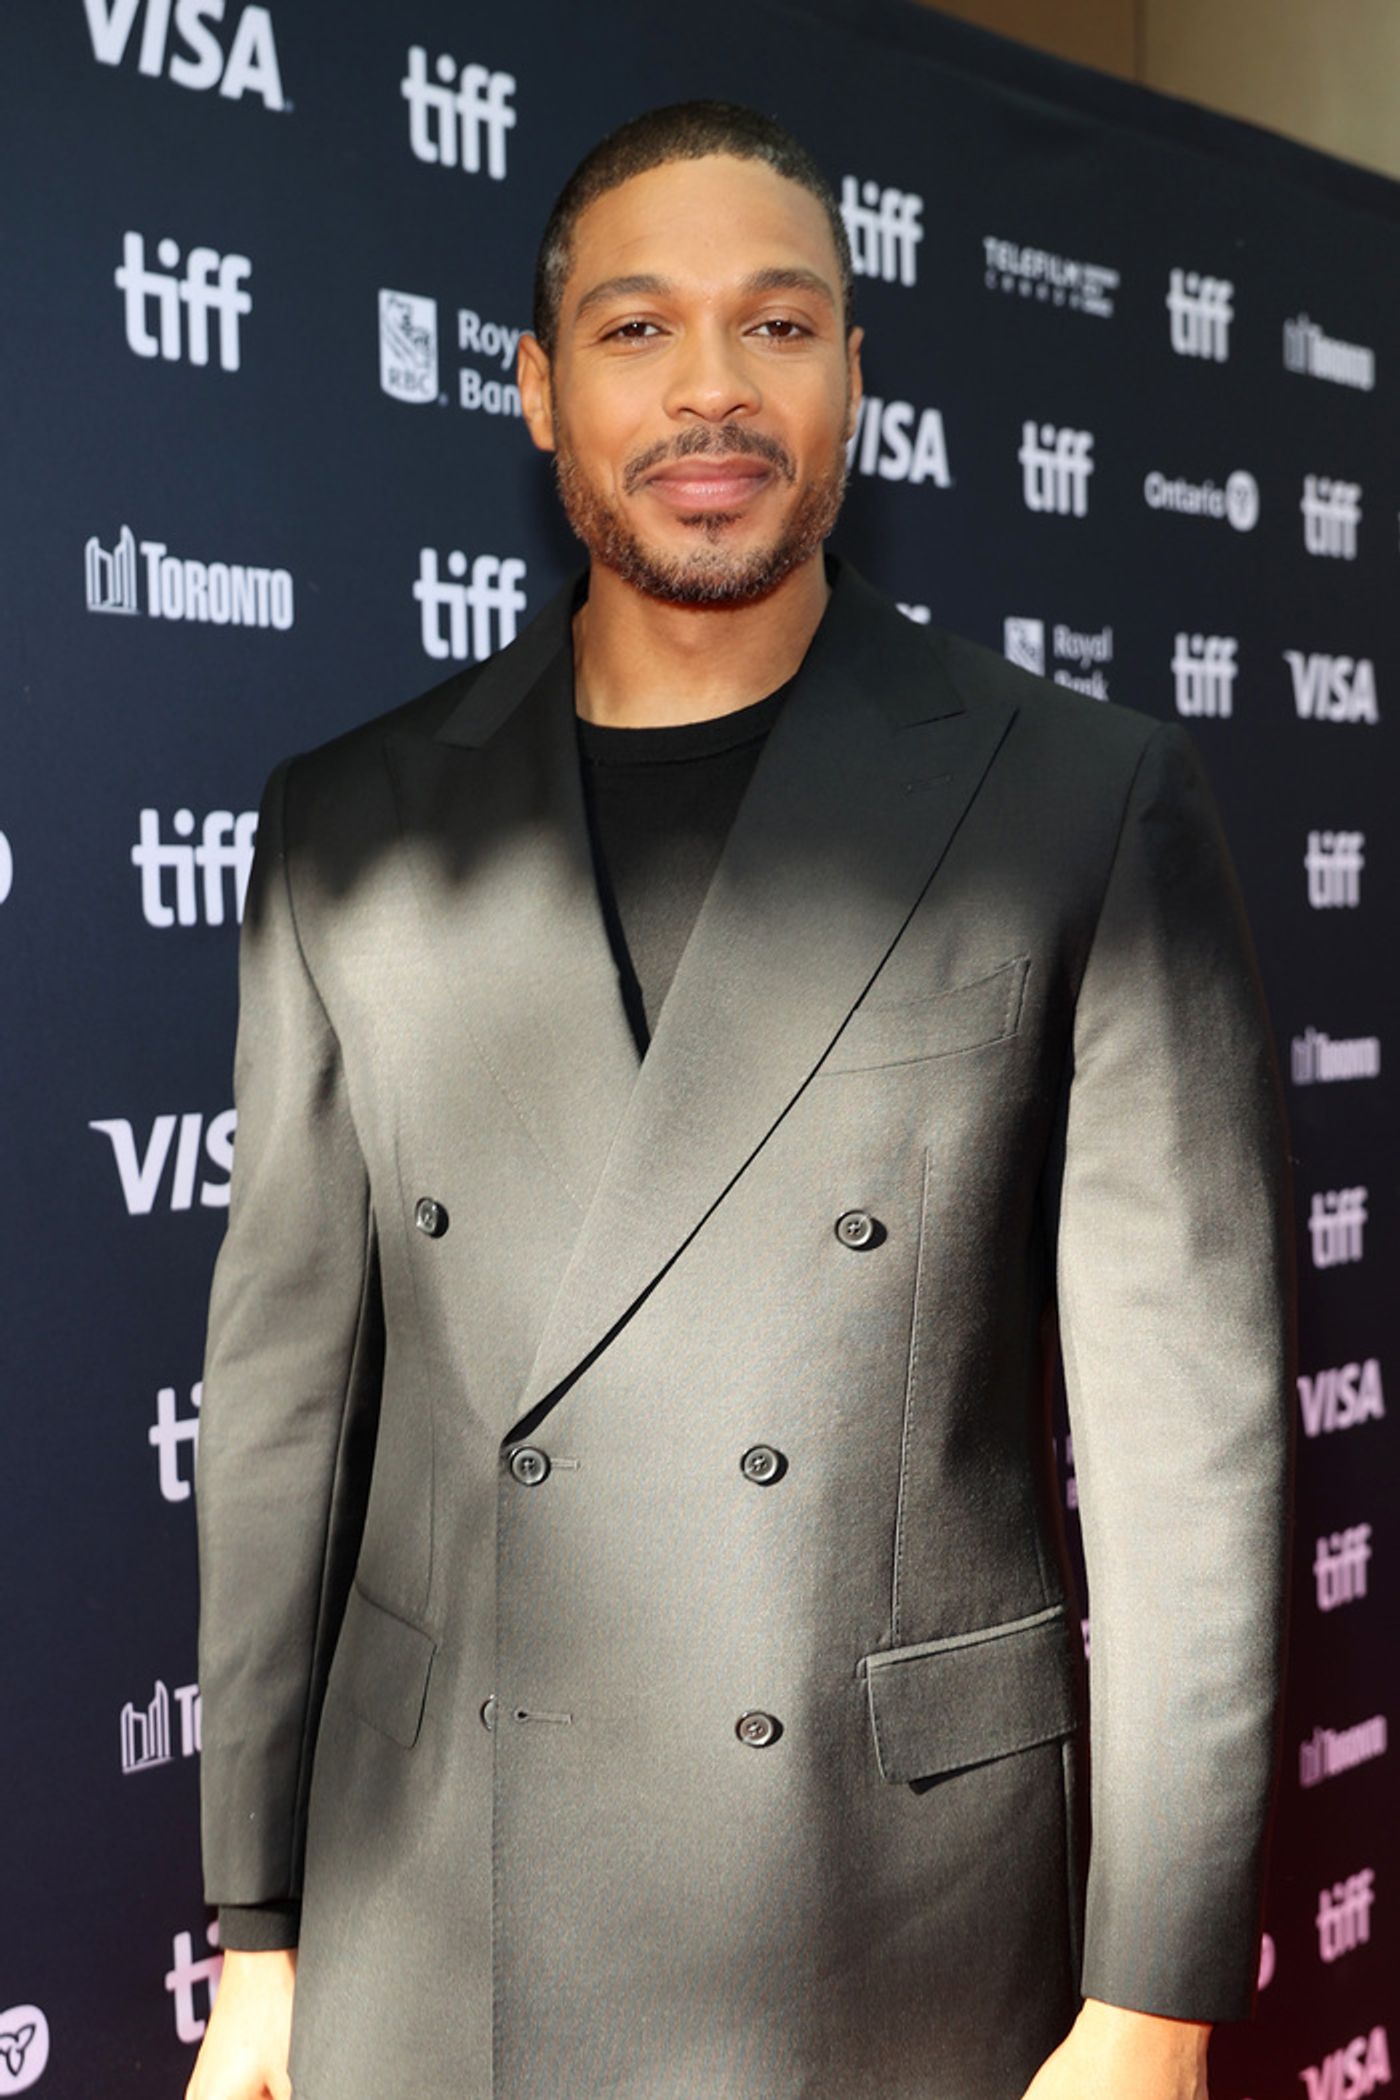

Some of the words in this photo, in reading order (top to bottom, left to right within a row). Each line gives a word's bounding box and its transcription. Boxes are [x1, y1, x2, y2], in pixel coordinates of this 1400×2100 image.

[84, 0, 284, 111] VISA
[401, 46, 516, 180] tiff
[840, 175, 923, 287] tiff
[114, 231, 252, 372] tiff
[458, 309, 520, 371] Roy
[1166, 269, 1234, 362] tiff
[459, 368, 523, 417] Ban
[1019, 421, 1094, 517] tiff
[1144, 471, 1226, 518] Ontario
[1301, 475, 1361, 559] tiff
[139, 541, 294, 630] TORONTO
[412, 547, 526, 661] tiff
[1172, 633, 1237, 718] tiff
[1285, 650, 1378, 724] VISA
[1304, 831, 1364, 909] tiff
[89, 1109, 237, 1215] VIS
[1308, 1186, 1368, 1268] tiff
[1296, 1358, 1385, 1437] VISA
[1313, 1523, 1372, 1611] tiff
[1316, 1868, 1374, 1962] tiff
[1301, 2026, 1391, 2100] VISA
